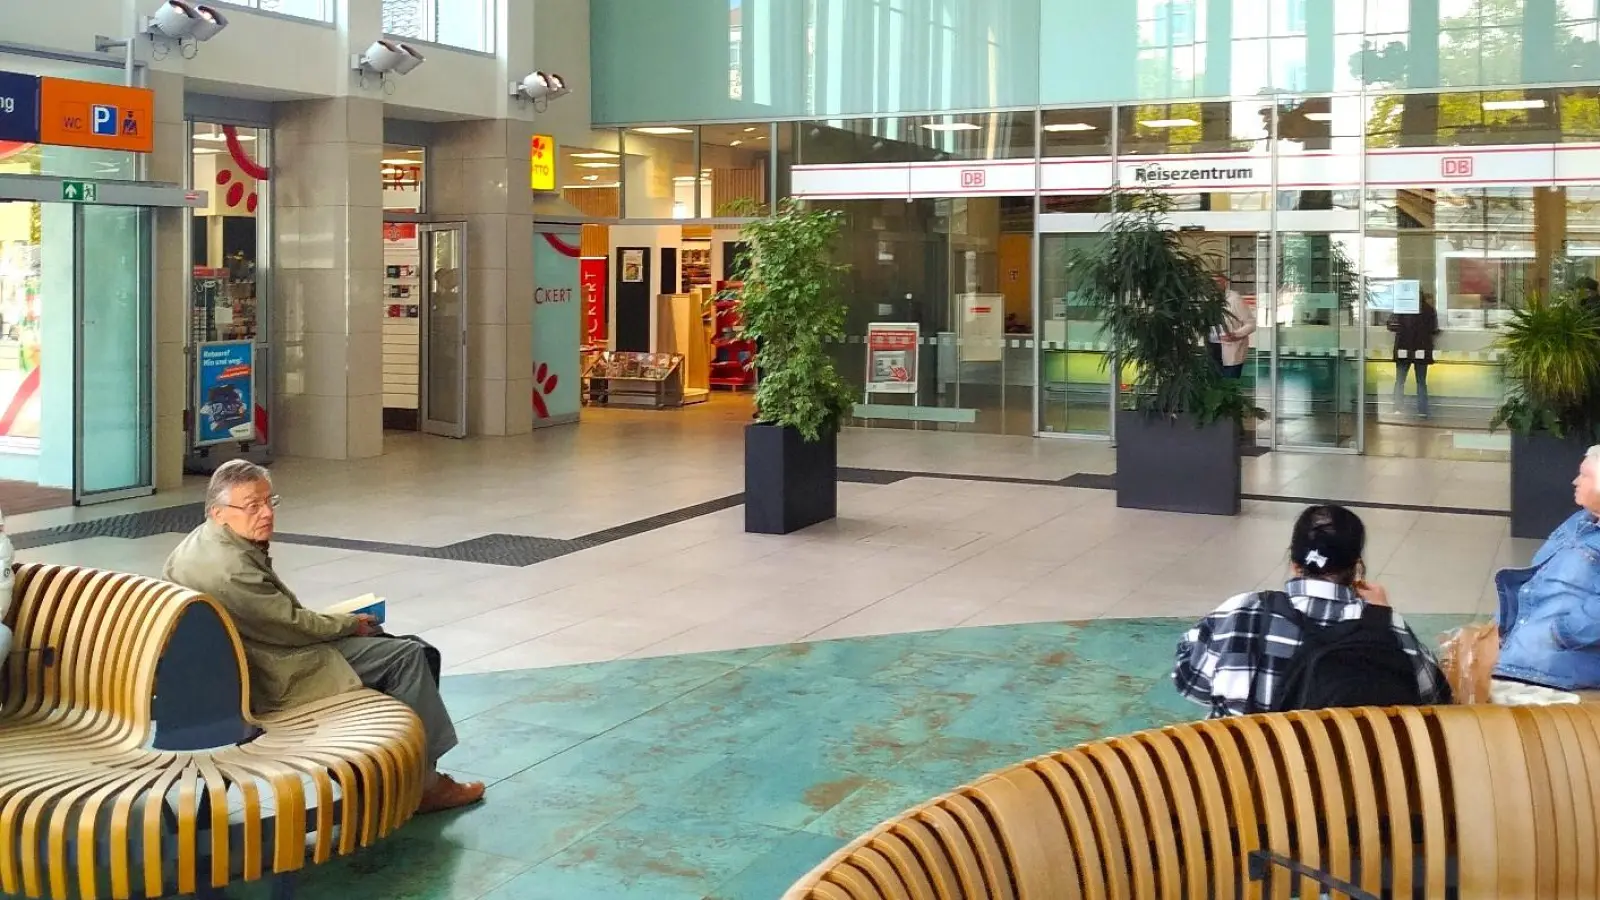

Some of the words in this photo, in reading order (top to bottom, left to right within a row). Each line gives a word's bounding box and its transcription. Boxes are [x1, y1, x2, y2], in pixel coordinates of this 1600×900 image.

[64, 116, 82, 129] WC
[94, 106, 111, 133] P
[532, 163, 550, 176] TTO
[1135, 166, 1253, 181] Reisezentrum
[1444, 159, 1471, 175] DB
[963, 171, 983, 186] DB
[535, 287, 572, 304] CKERT
